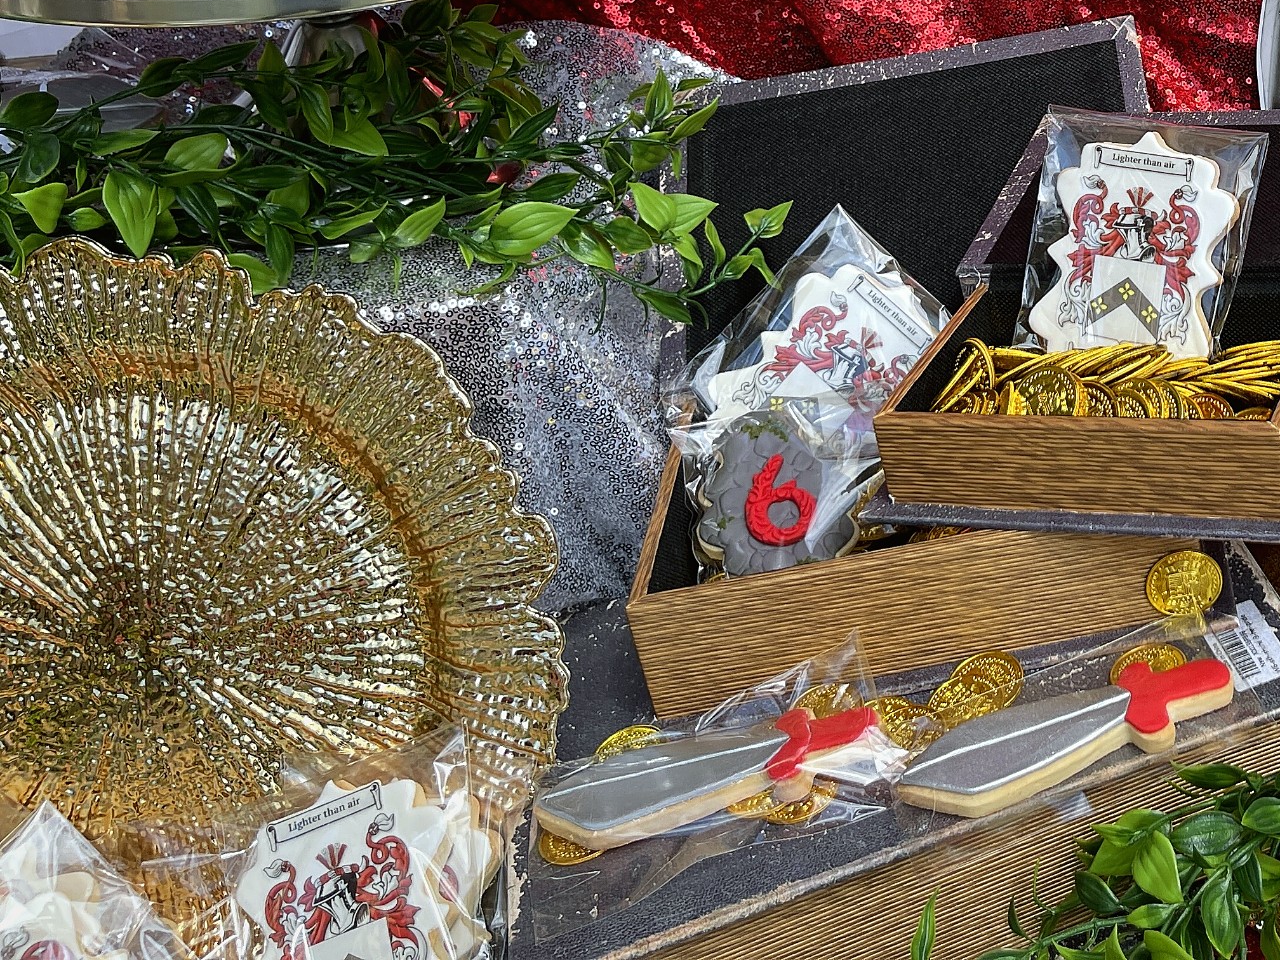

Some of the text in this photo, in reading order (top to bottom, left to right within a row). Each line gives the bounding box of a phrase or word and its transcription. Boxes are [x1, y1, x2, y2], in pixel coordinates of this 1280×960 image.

[1112, 152, 1177, 170] Lighter than air
[867, 289, 919, 337] Lighter than air
[744, 453, 818, 547] 6
[288, 797, 362, 833] Lighter than air
